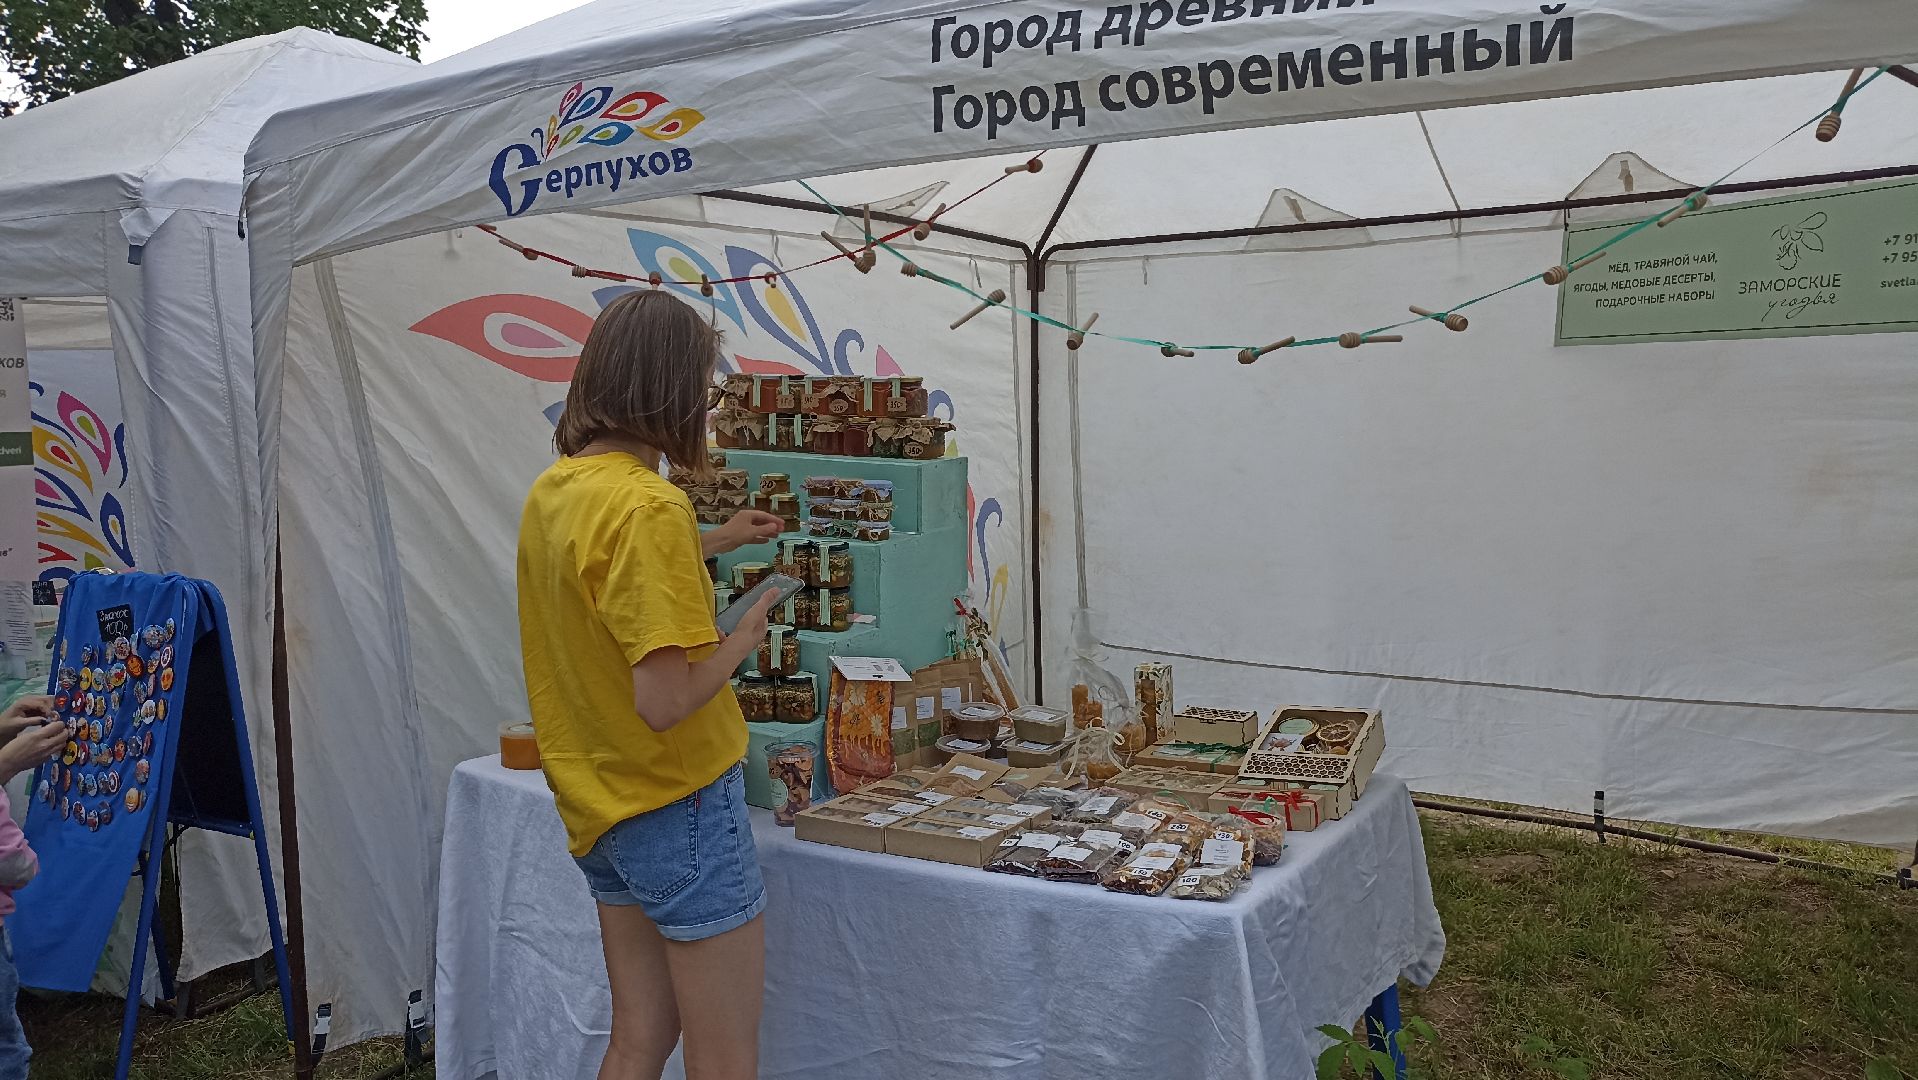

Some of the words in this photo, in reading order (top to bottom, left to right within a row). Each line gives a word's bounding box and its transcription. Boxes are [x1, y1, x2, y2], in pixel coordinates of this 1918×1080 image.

[930, 9, 1083, 68] Город
[933, 80, 1086, 140] Город
[1098, 2, 1574, 114] современный
[488, 142, 693, 217] Серпухов
[1883, 234, 1901, 246] +7
[1608, 261, 1631, 273] МЁД,
[1634, 253, 1690, 270] ТРАВЯНОЙ
[1692, 251, 1718, 265] ЧАЙ,
[1882, 252, 1899, 264] +7
[1573, 281, 1608, 293] ЯГОДЫ,
[1610, 276, 1661, 290] МЕДОВЫЕ
[1662, 271, 1716, 286] ДЕСЕРТЫ,
[1737, 273, 1843, 295] ЗАМОРСКИЕ
[1595, 293, 1665, 309] ПОДАРОЧНЫЕ
[1667, 290, 1715, 302] НАБОРЫ
[1760, 290, 1840, 322] угодья
